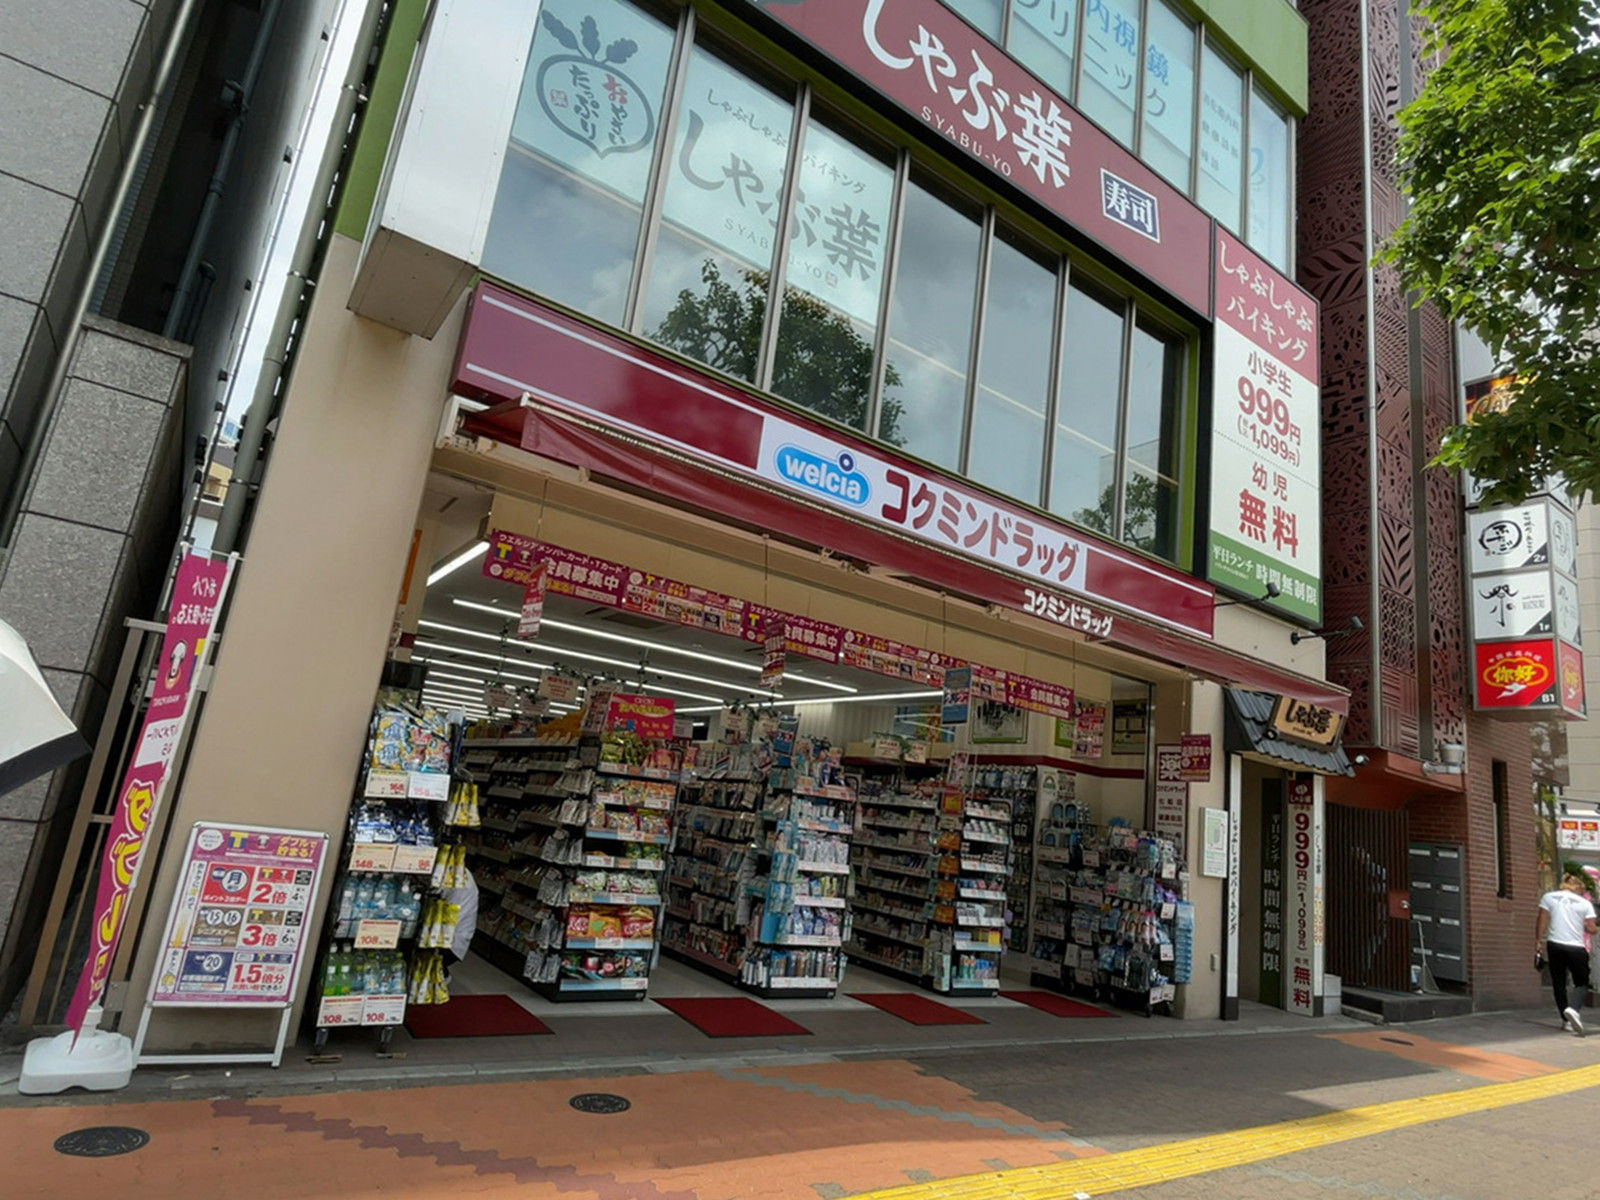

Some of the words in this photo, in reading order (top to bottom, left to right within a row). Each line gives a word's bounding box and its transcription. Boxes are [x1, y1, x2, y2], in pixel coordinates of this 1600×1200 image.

[1015, 0, 1167, 117] リニック
[862, 0, 1073, 189] しゃぶ葉
[706, 88, 787, 149] しゃぶしゃぶ
[802, 154, 867, 194] バイキング
[920, 105, 1012, 177] SYABU-YO
[1104, 176, 1154, 235] 寿司
[1220, 239, 1313, 333] しゃぶしゃぶ
[1226, 295, 1309, 362] バイキング
[1247, 350, 1293, 398] 小学生
[1237, 374, 1301, 447] 999円
[784, 453, 862, 501] welcia
[1252, 461, 1288, 502] 幼児
[881, 468, 1081, 583] コクミンドラッグ
[1238, 487, 1299, 559] 無料
[1212, 544, 1255, 574] 平日ランチ
[1022, 587, 1115, 638] コクミンドラッグ
[1493, 665, 1536, 683] 你好
[1160, 754, 1181, 780] 薬
[228, 871, 243, 886] 月
[1262, 868, 1281, 972] 時間無制限
[322, 1014, 342, 1024] 108
[365, 1012, 385, 1023] 108
